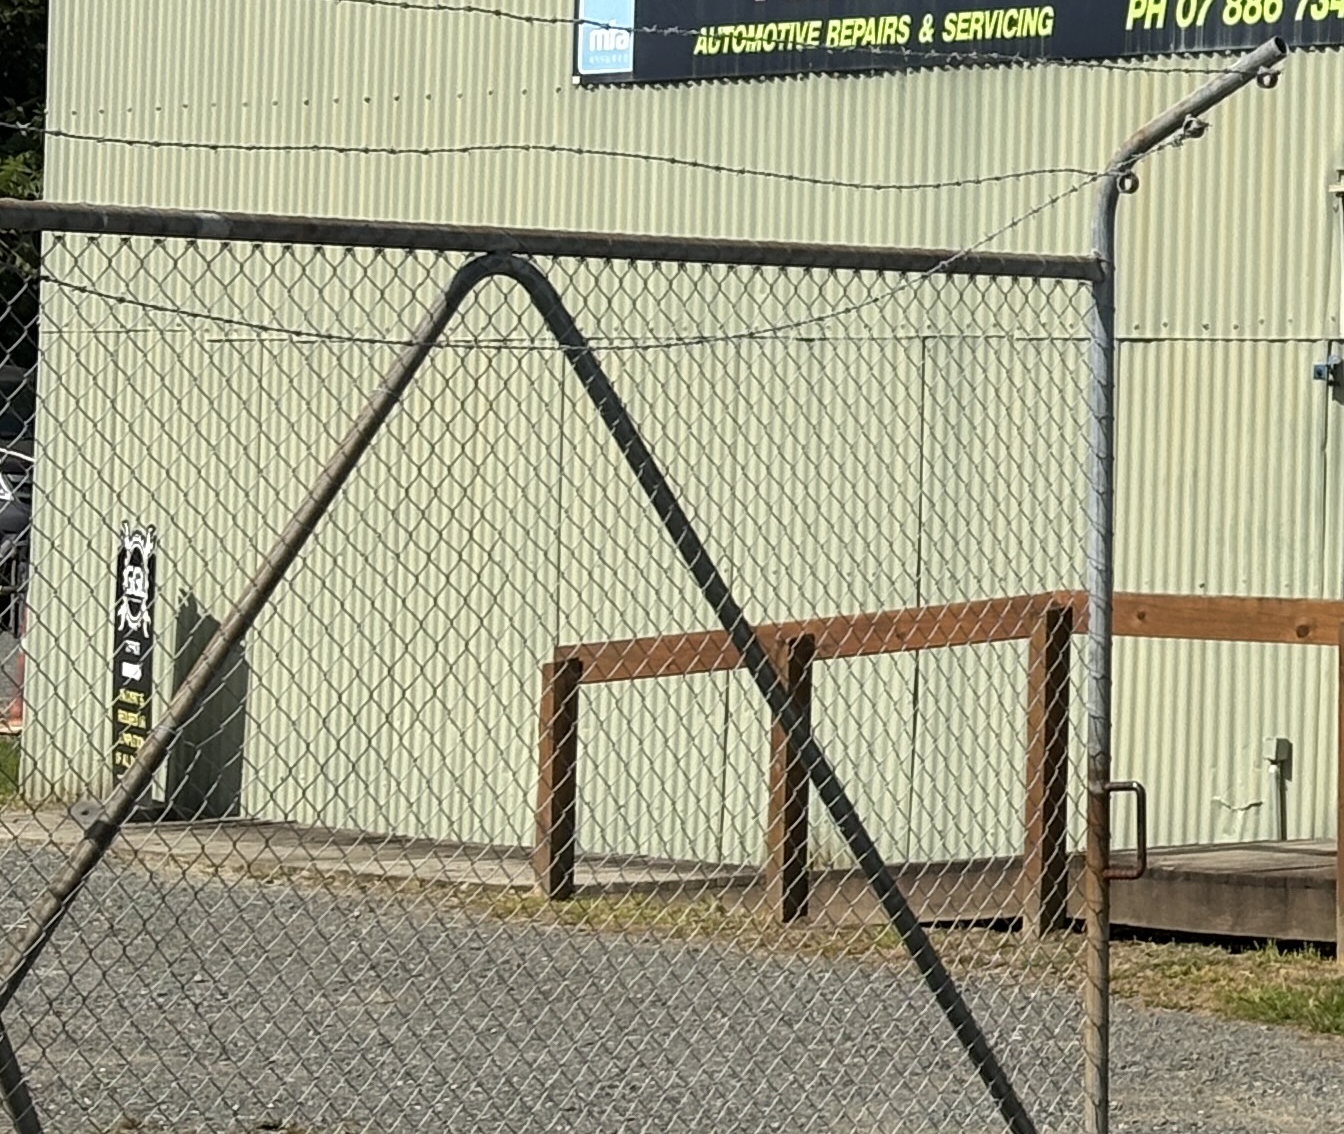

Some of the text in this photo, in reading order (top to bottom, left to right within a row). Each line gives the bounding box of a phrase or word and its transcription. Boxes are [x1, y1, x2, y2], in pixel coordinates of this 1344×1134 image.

[693, 6, 1055, 56] AUTOMOTIVE REPAIRS & SERVICING
